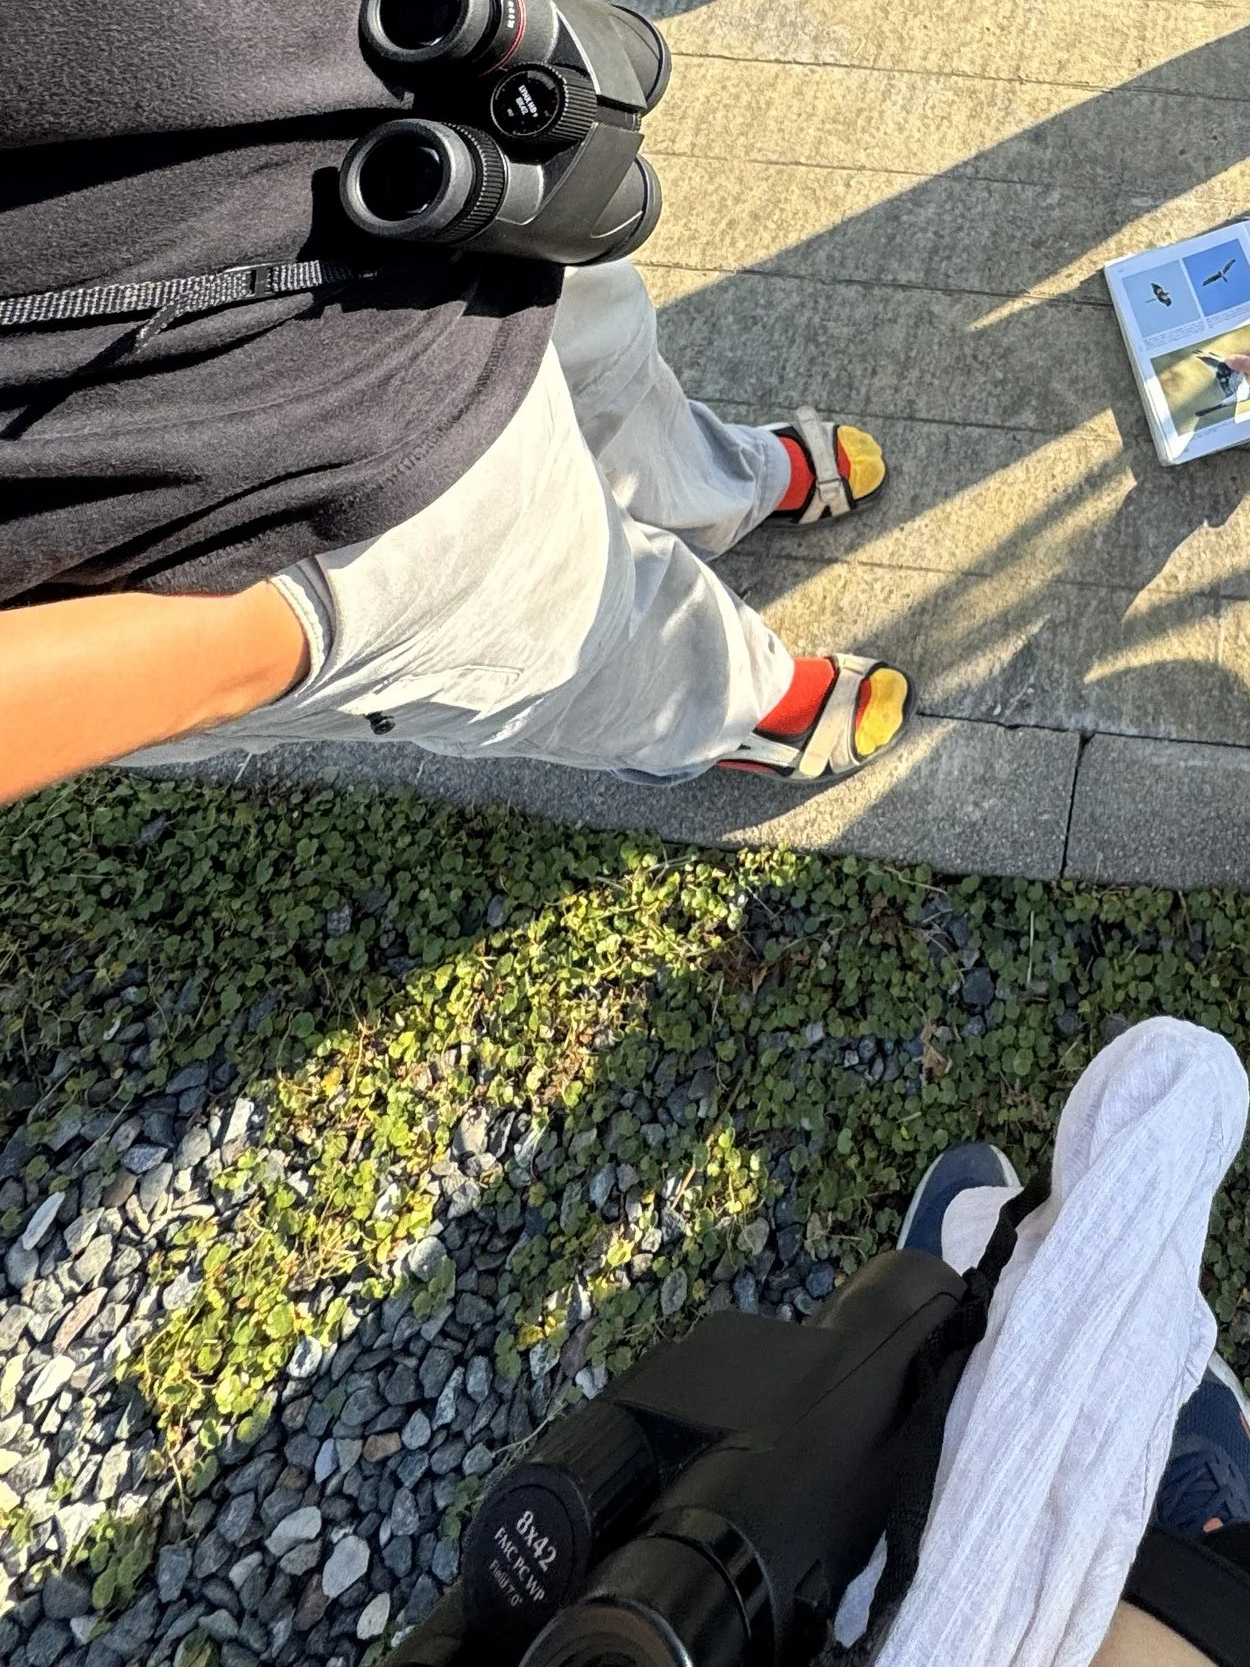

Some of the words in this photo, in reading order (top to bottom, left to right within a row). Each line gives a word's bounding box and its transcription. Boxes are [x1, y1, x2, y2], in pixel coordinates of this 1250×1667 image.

[494, 1526, 519, 1562] FMC
[512, 1555, 531, 1581] PC
[526, 1574, 545, 1602] WP
[516, 1510, 557, 1573] 8x42
